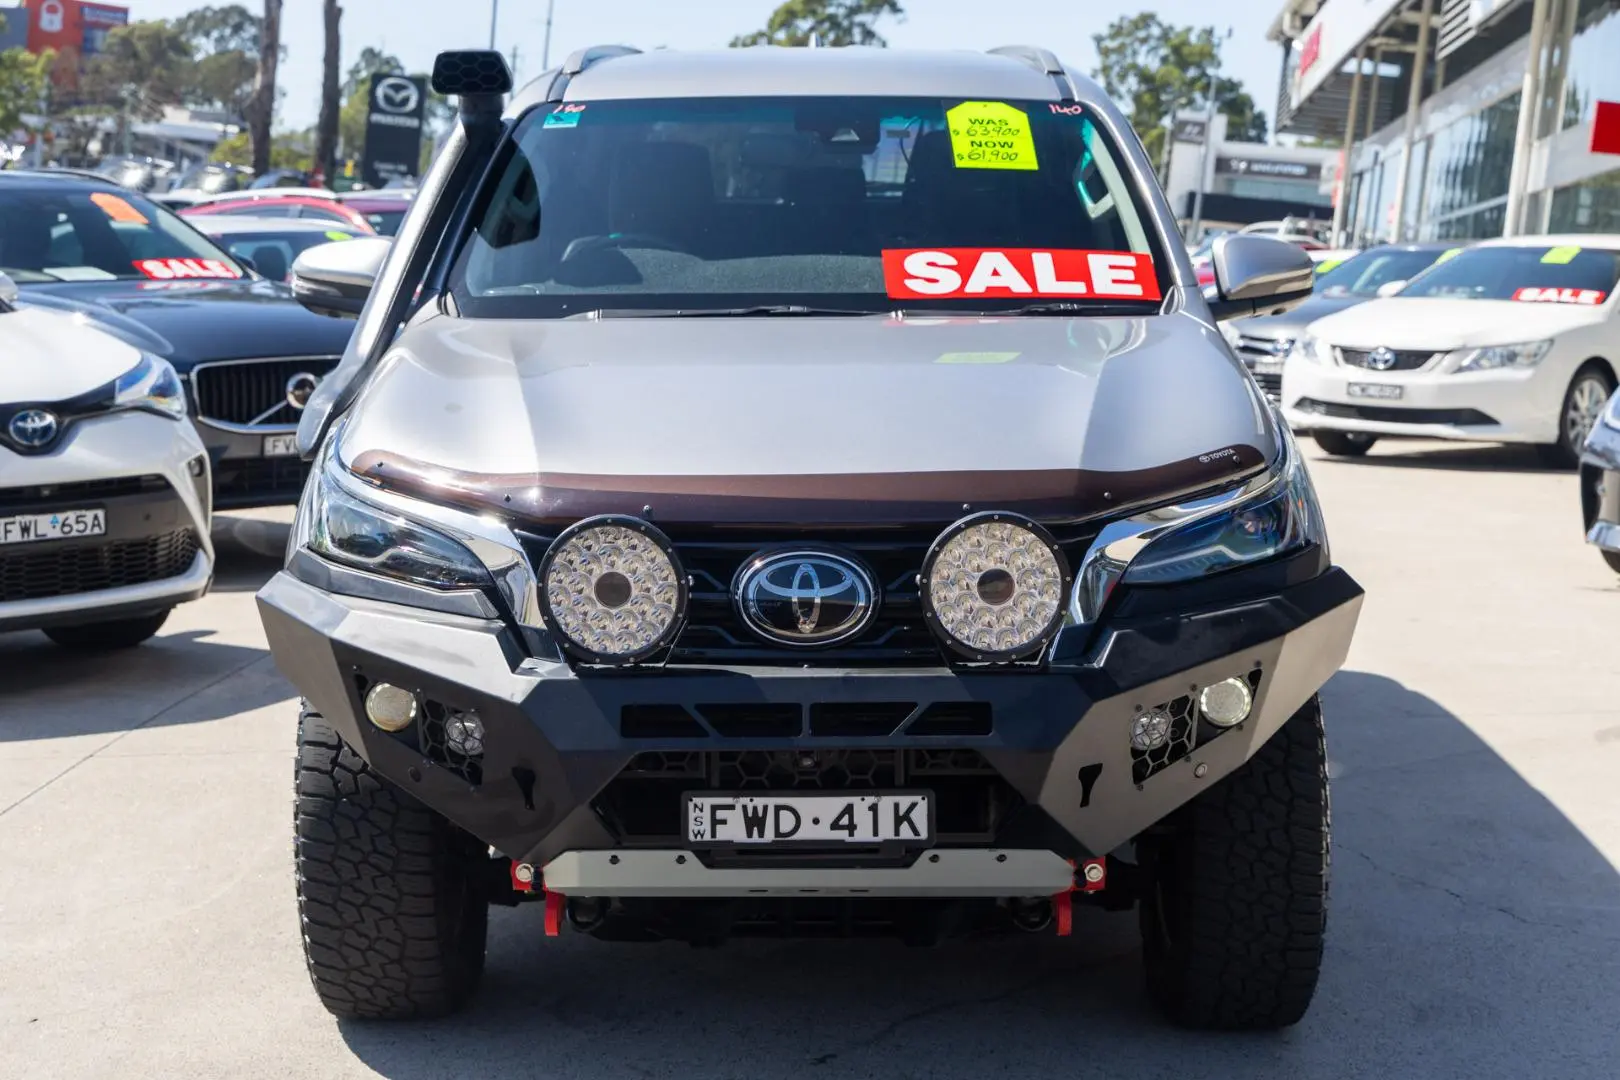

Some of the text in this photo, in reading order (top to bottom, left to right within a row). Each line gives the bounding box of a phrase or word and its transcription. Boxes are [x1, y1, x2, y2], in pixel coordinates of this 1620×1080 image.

[968, 118, 1009, 126] WAS
[970, 140, 1014, 149] NOW
[142, 259, 237, 278] SALE
[903, 251, 1144, 295] SALE
[1518, 287, 1600, 304] SALE
[1209, 448, 1236, 460] TOYOTA
